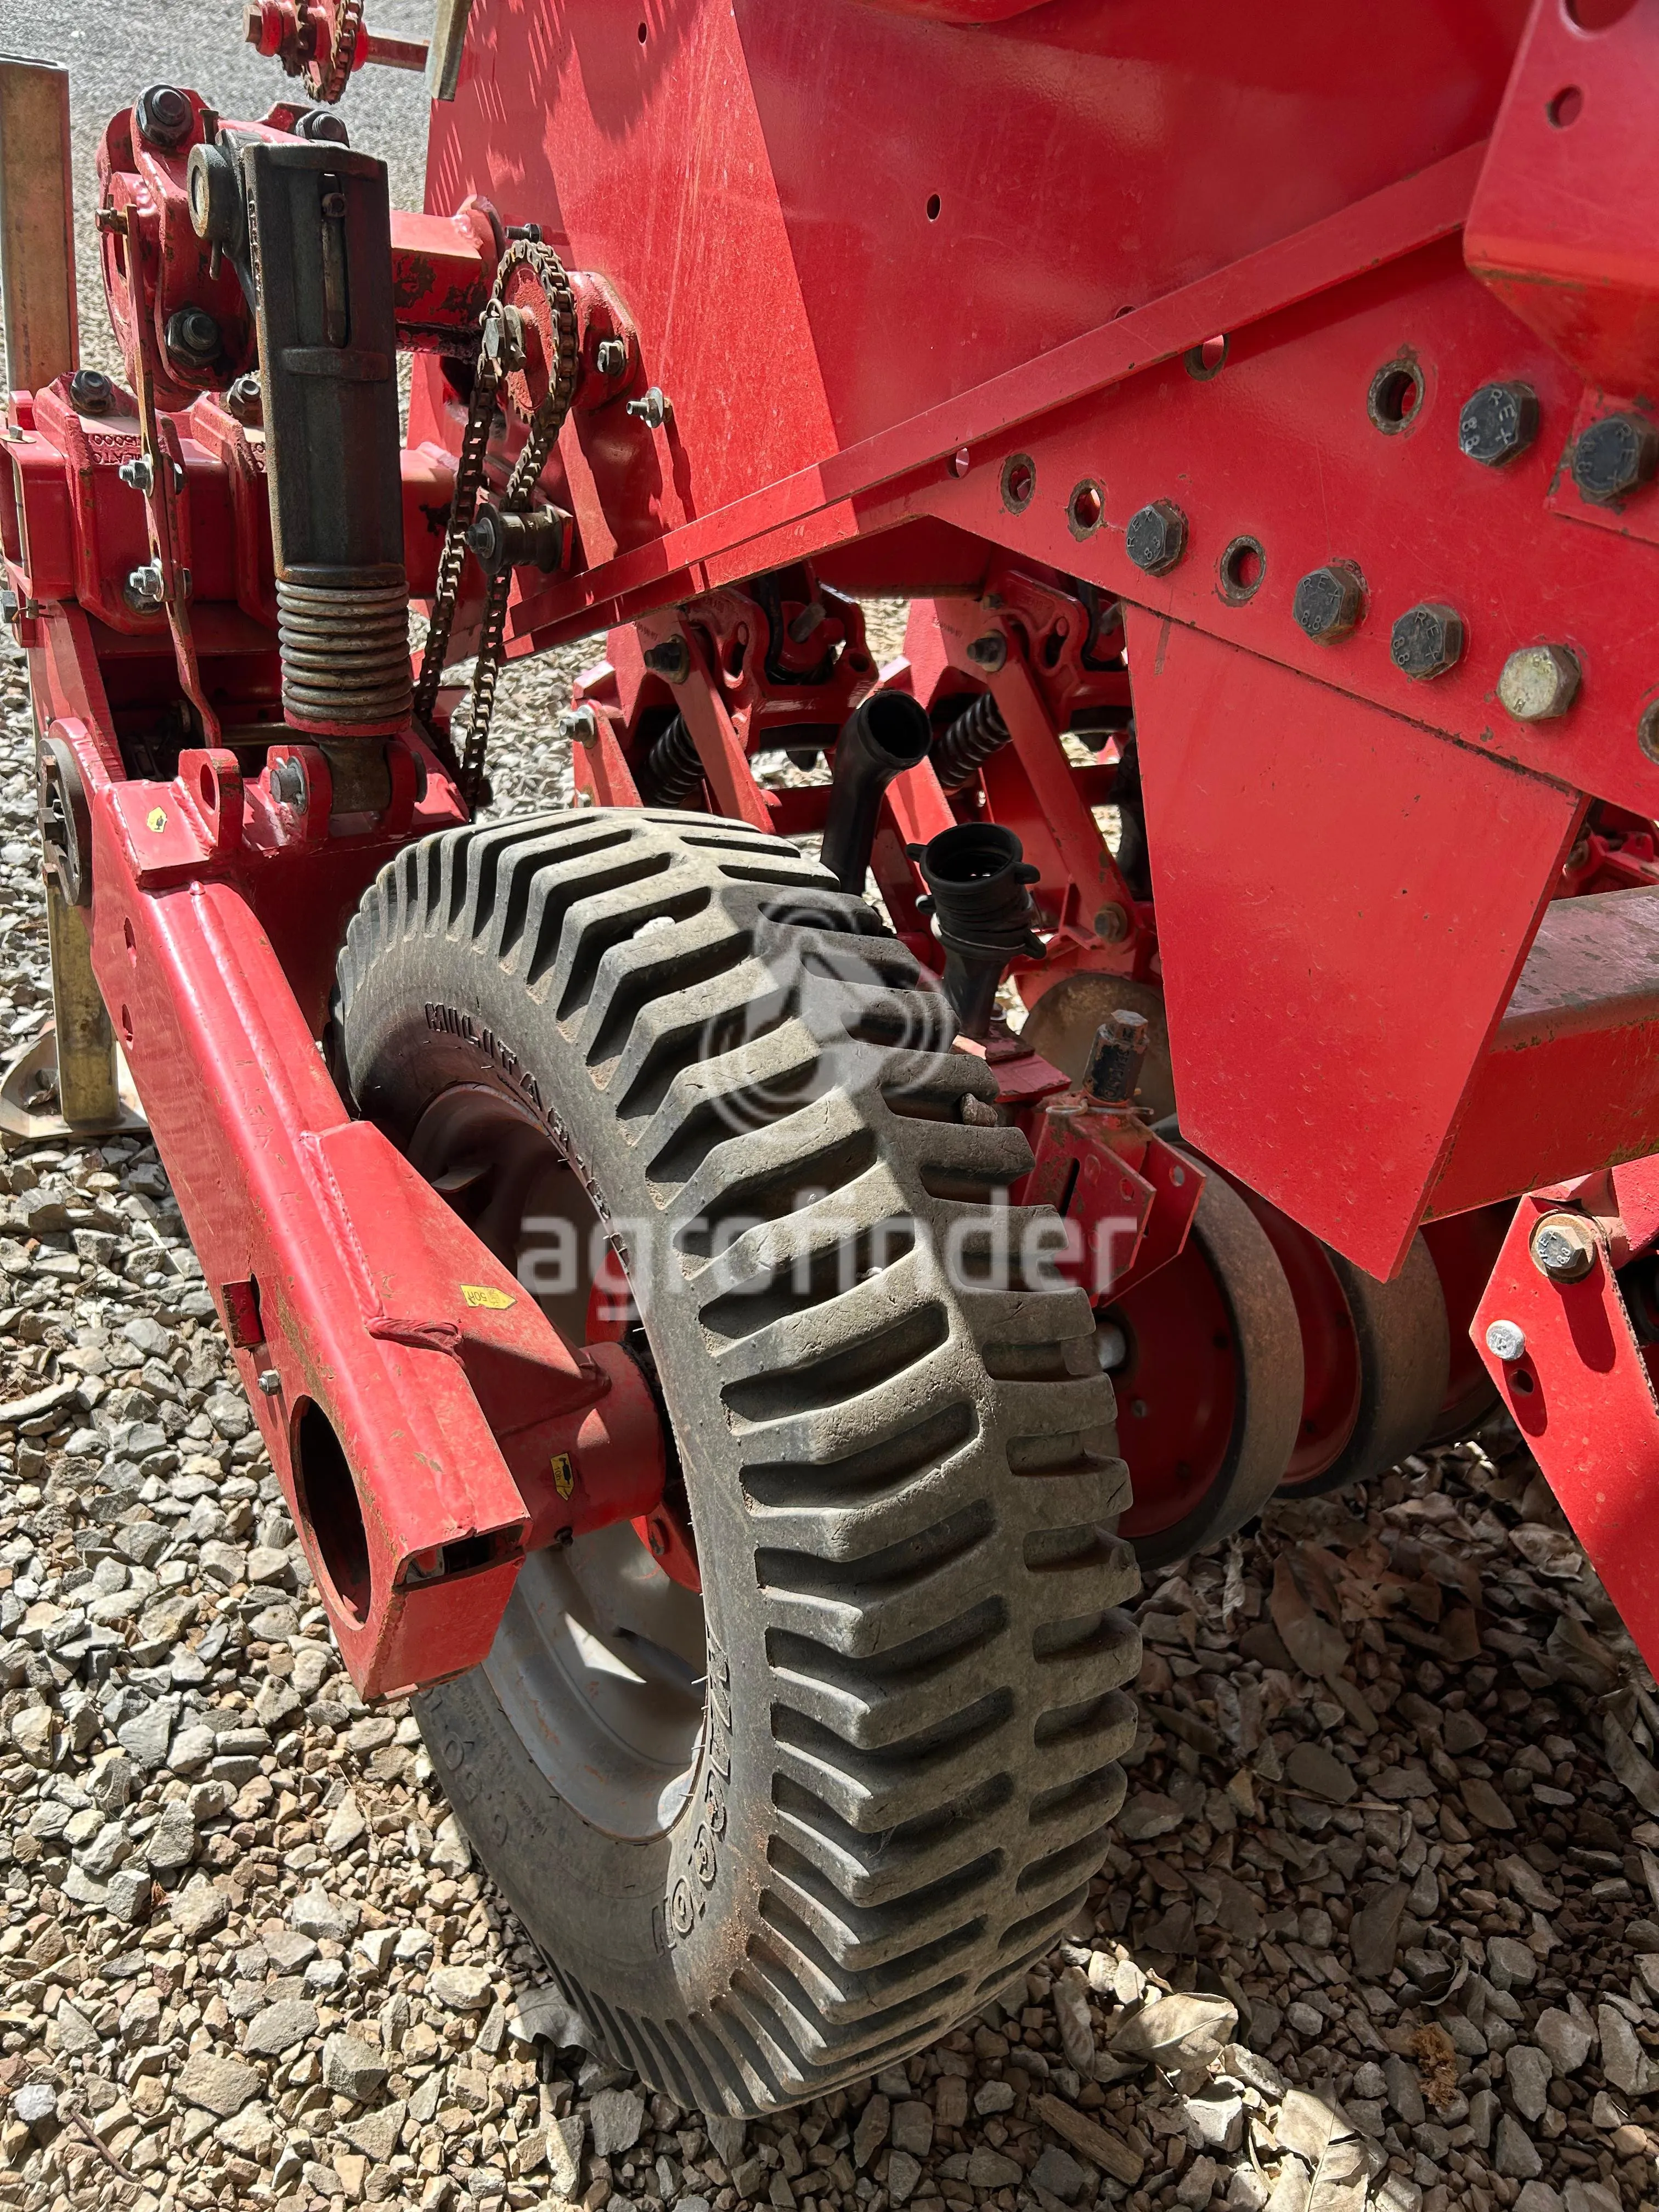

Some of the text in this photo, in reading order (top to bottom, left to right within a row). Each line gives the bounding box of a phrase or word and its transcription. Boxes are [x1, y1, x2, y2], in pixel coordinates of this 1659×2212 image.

[1488, 388, 1515, 444] REX
[1462, 416, 1480, 451] 8.8
[1126, 509, 1153, 548] REX
[1302, 575, 1342, 603] REX
[1301, 610, 1322, 630] 8.8
[1414, 610, 1440, 660] REX
[1393, 636, 1410, 665] 8.8
[1537, 1230, 1558, 1259] REX
[467, 1291, 488, 1302] 50h
